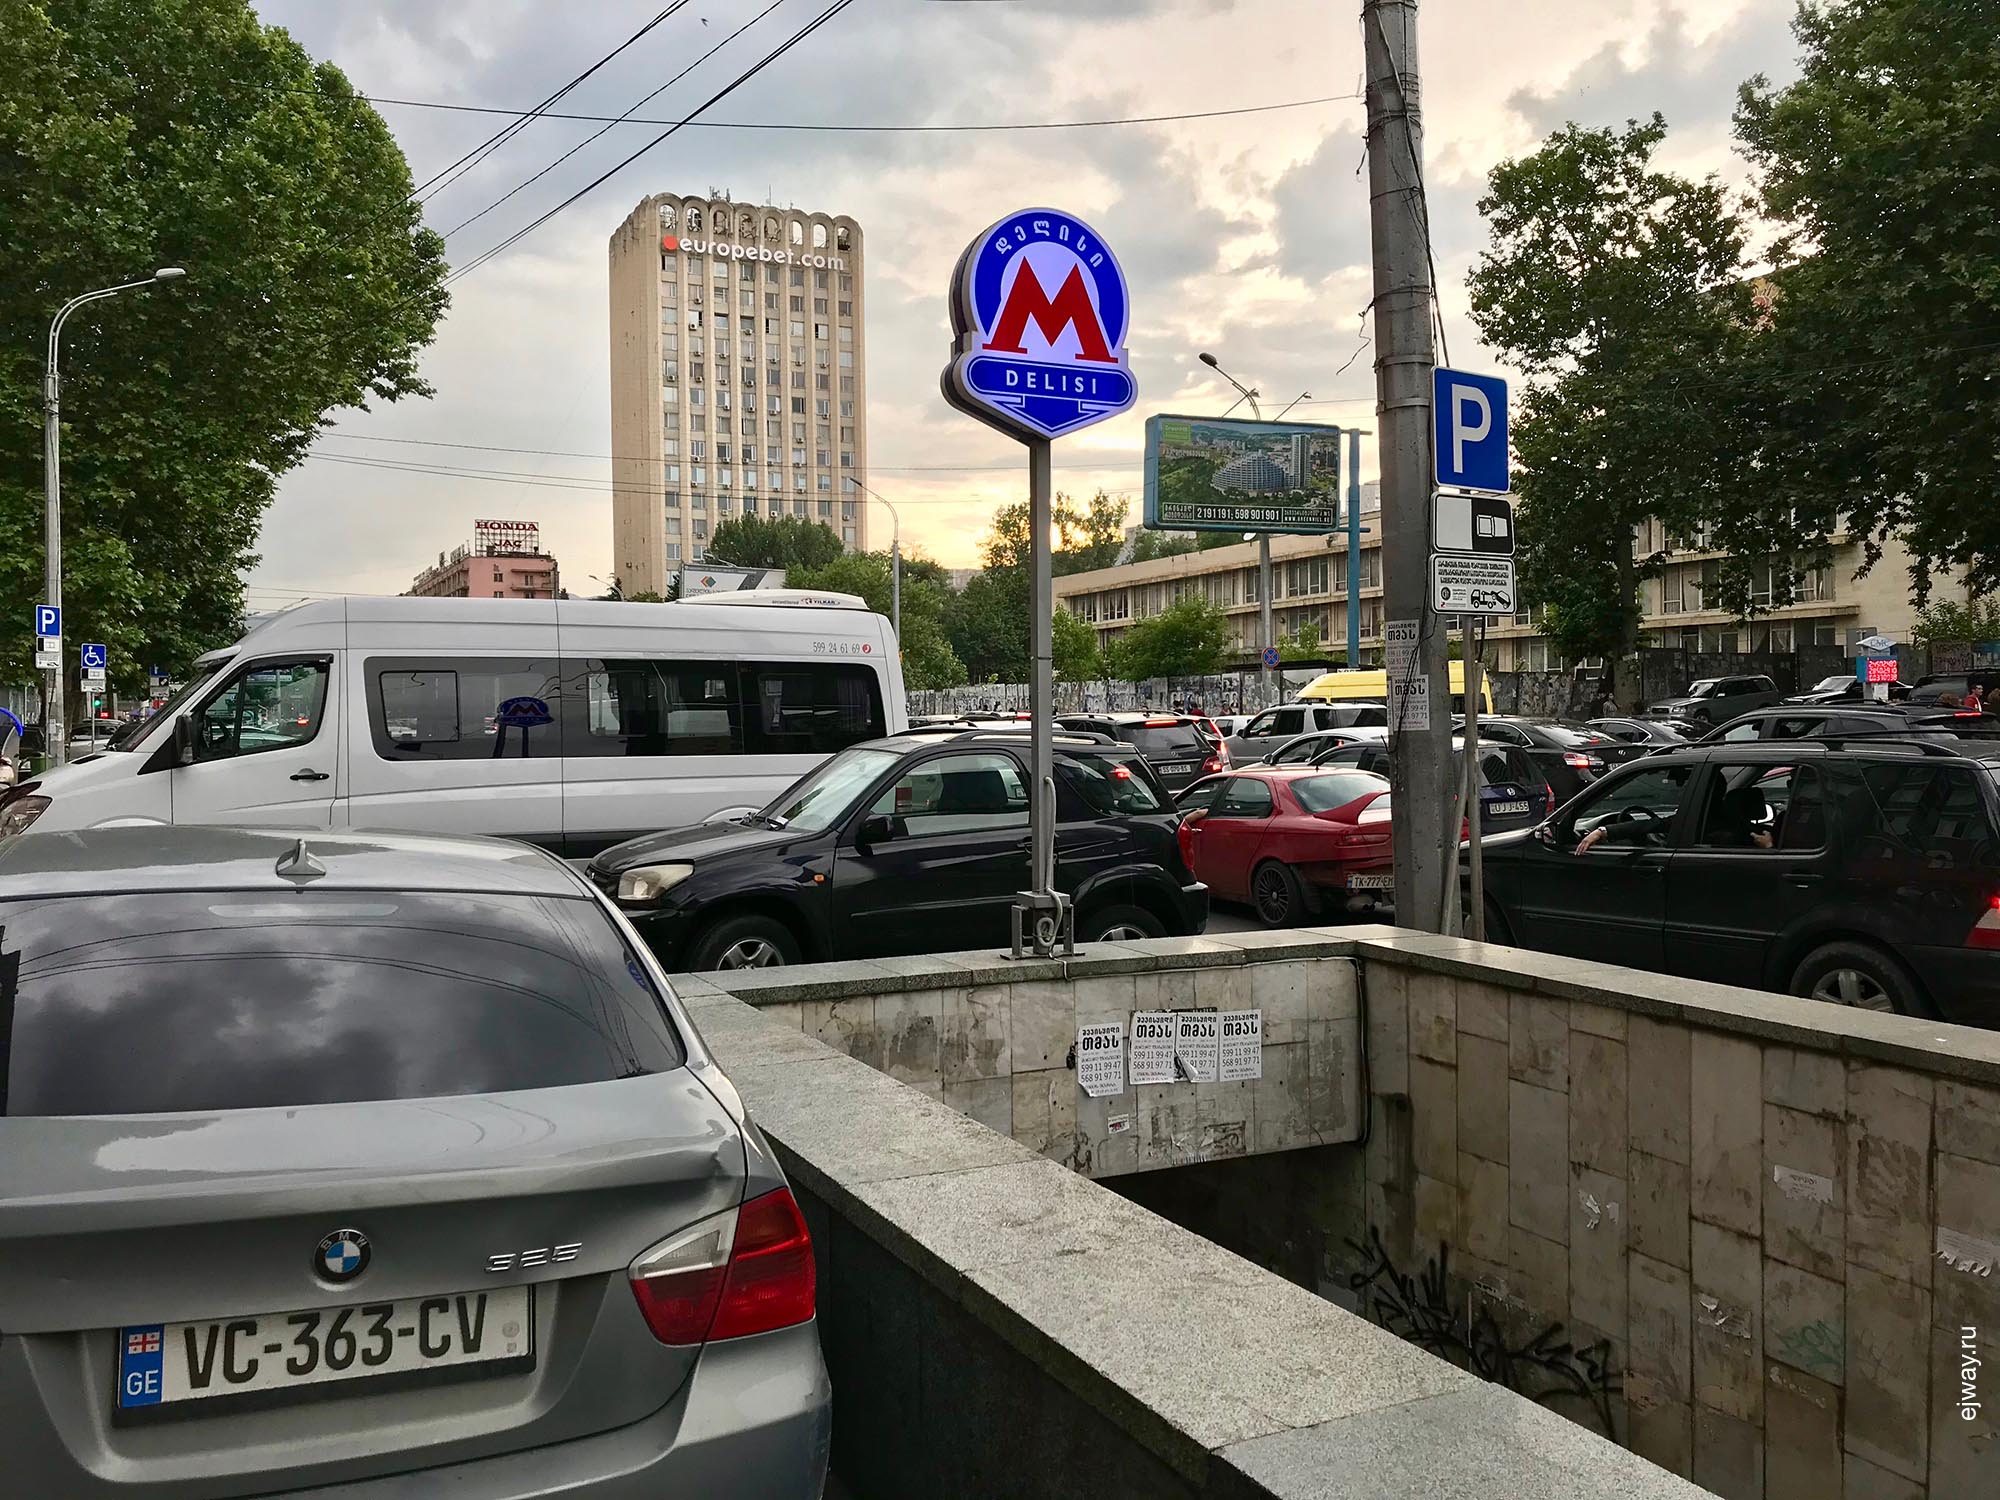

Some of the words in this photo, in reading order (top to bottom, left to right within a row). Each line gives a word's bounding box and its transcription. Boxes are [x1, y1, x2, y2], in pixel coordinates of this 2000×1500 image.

[995, 220, 1104, 268] დელისი
[679, 237, 845, 271] europebet.com
[982, 256, 1119, 364] M
[1006, 369, 1097, 394] DELISI
[1451, 383, 1492, 473] P
[1235, 508, 1249, 520] 598
[1250, 509, 1280, 521] 901901
[475, 521, 539, 532] HONDA
[493, 540, 522, 548] JAC
[42, 609, 56, 633] P
[1387, 629, 1416, 641] თმას
[813, 641, 826, 653] 599
[828, 642, 837, 653] 24
[840, 643, 848, 654] 61
[851, 643, 860, 654] 69
[1136, 1024, 1172, 1038] თმას
[1180, 1023, 1216, 1037] თმას
[1223, 1021, 1258, 1036] თმას
[1082, 1035, 1119, 1051] თმას
[1133, 1050, 1146, 1060] 599
[1147, 1050, 1154, 1059] 11
[1155, 1050, 1164, 1059] 99
[1164, 1050, 1173, 1058] 47
[1190, 1050, 1198, 1058] 11
[1199, 1049, 1208, 1058] 99
[1222, 1048, 1234, 1058] 599
[1235, 1048, 1242, 1056] 11
[1243, 1047, 1251, 1056] 99
[1252, 1046, 1260, 1055] 47
[1081, 1063, 1093, 1073] 599
[1094, 1062, 1102, 1071] 11
[1103, 1061, 1112, 1071] 99
[1113, 1060, 1121, 1069] 47
[1146, 1060, 1154, 1070] 91
[1155, 1060, 1164, 1069] 97
[1165, 1060, 1172, 1069] 71
[1199, 1059, 1207, 1068] 97
[1208, 1059, 1216, 1068] 71
[1234, 1057, 1242, 1066] 91
[1243, 1056, 1251, 1065] 97
[1253, 1055, 1260, 1064] 71
[1094, 1072, 1102, 1081] 91
[1103, 1071, 1112, 1080] 97
[1113, 1070, 1121, 1080] 71
[320, 1231, 368, 1251] BMW
[484, 1242, 583, 1272] 325
[184, 1293, 488, 1389] VC-363-CV
[126, 1369, 159, 1397] GE
